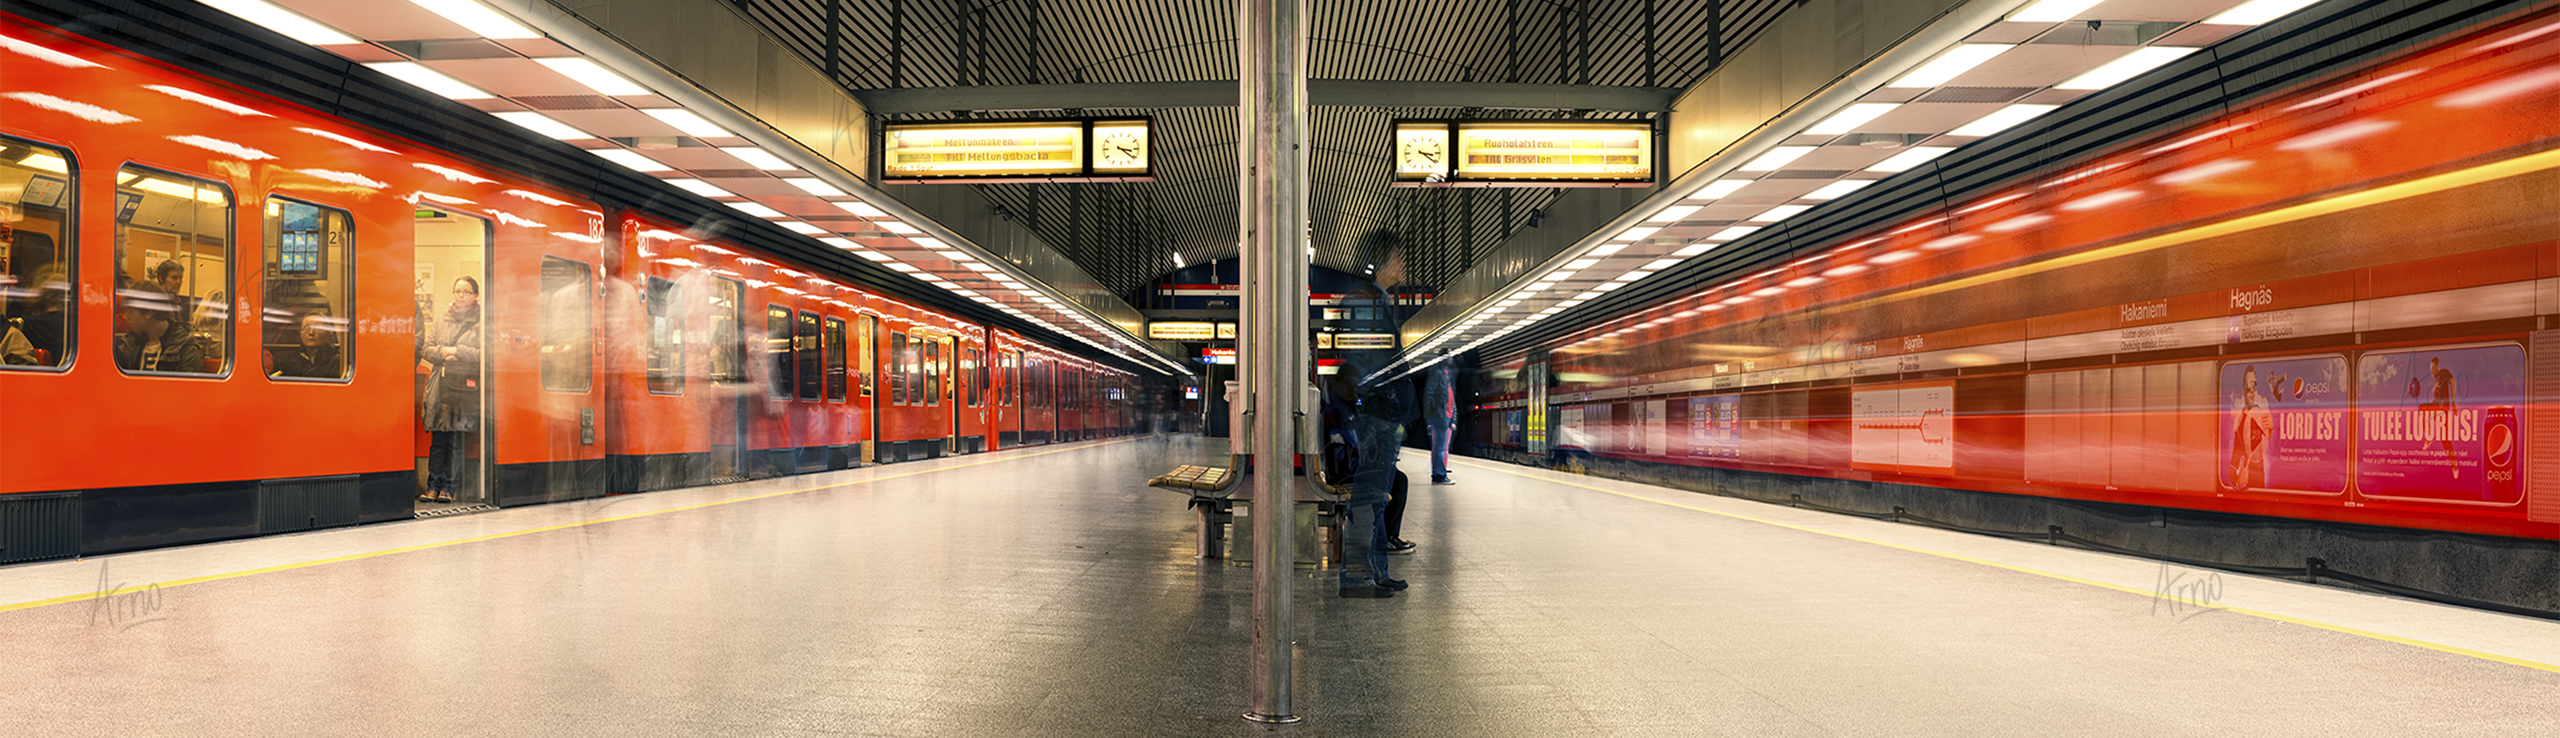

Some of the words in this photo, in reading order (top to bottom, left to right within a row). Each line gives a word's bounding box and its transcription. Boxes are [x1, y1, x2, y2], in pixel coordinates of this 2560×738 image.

[1484, 139, 1554, 148] Ruoholahteen
[946, 152, 964, 161] Till
[1485, 154, 1502, 164] Till
[2231, 284, 2272, 311] Hagnäs
[2121, 298, 2167, 322] Hakaniemi
[2305, 382, 2330, 396] pepsi
[2280, 411, 2313, 440] LORD
[2316, 411, 2342, 440] EST
[2362, 411, 2402, 441] TULEE
[2405, 409, 2479, 442] LUURIIS!
[2487, 468, 2513, 483] pepsi
